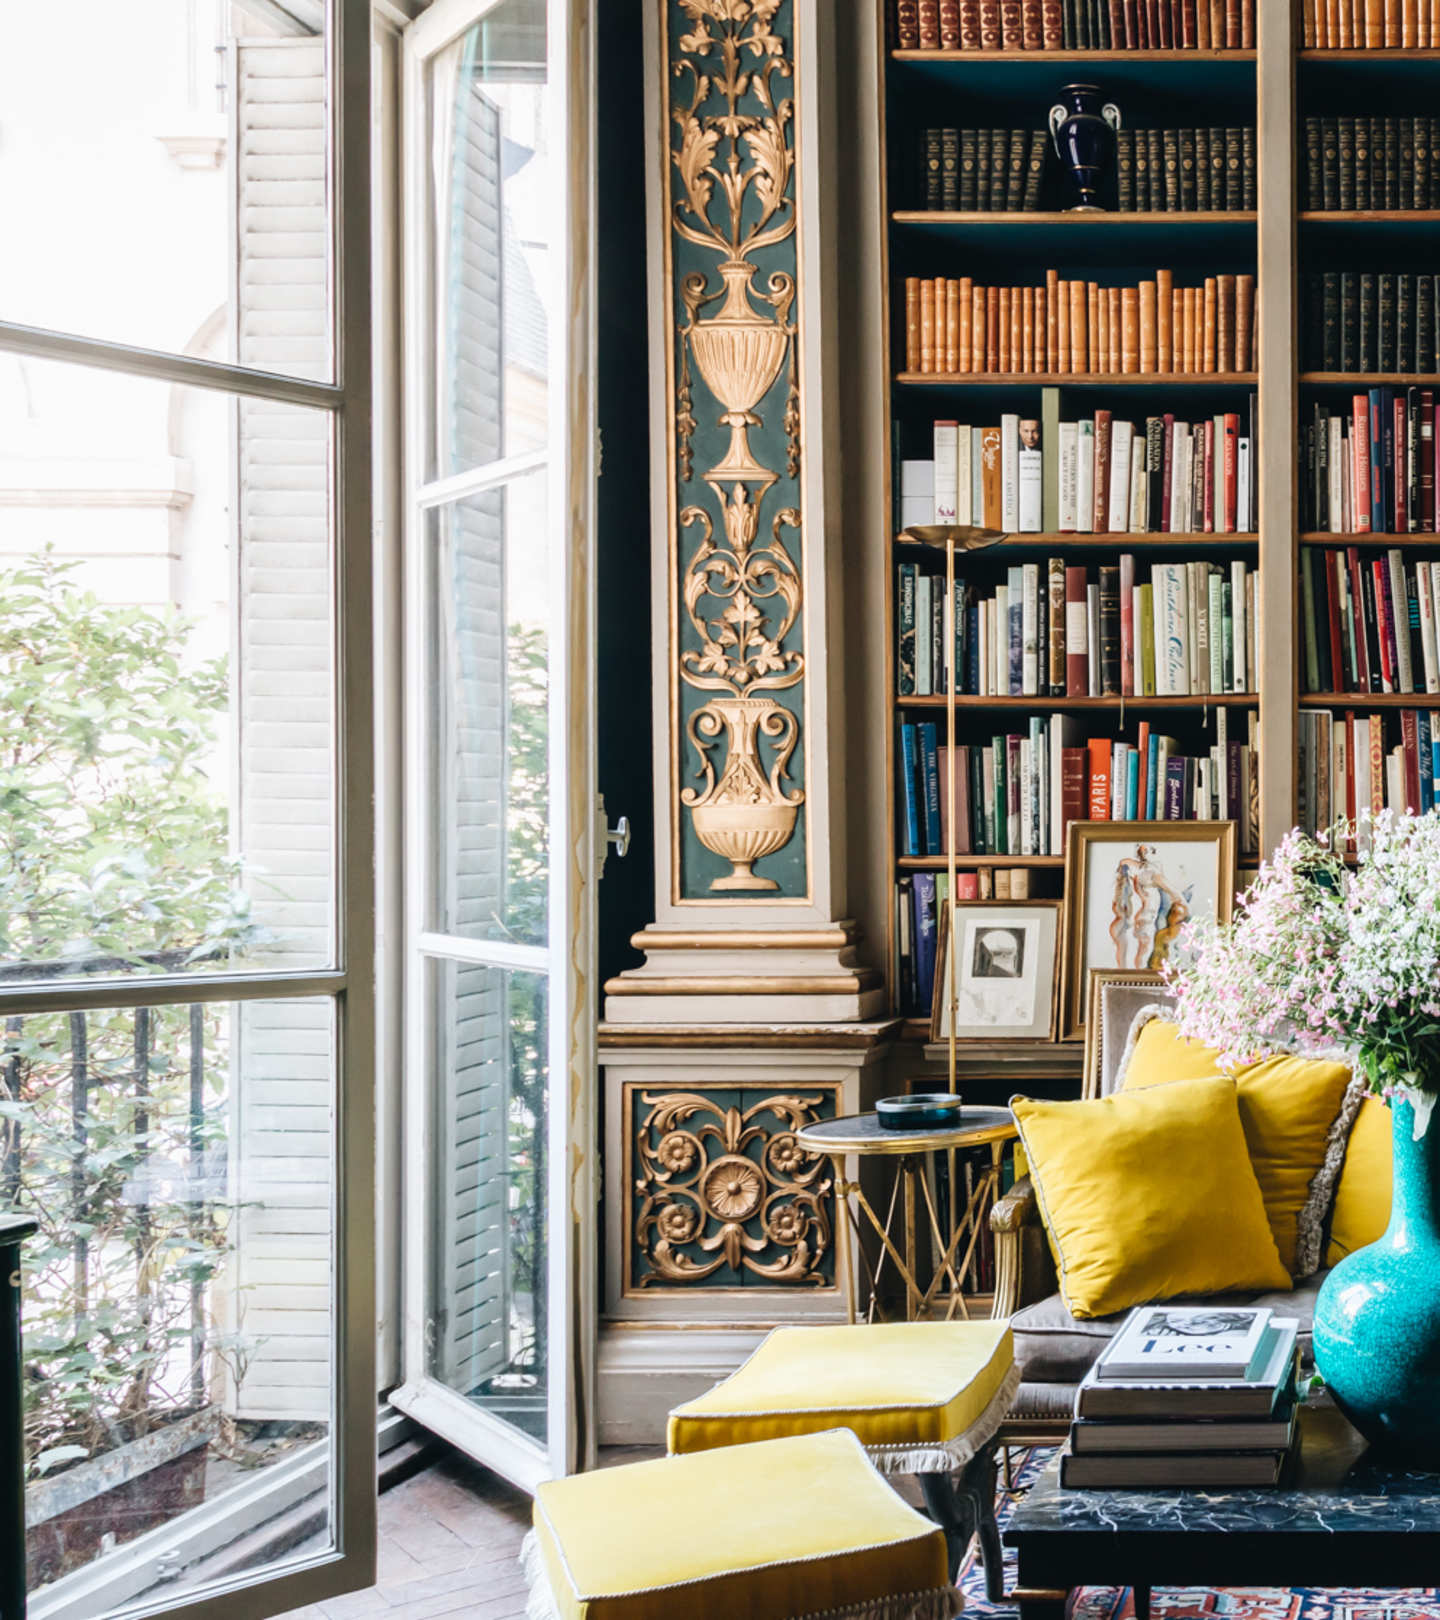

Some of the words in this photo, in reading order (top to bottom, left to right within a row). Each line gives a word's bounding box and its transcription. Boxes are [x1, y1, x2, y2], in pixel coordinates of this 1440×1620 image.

[1357, 415, 1369, 454] Russian
[1358, 455, 1369, 492] Houses
[1165, 567, 1184, 635] Southern
[1198, 608, 1208, 649] LEDOUX
[1168, 636, 1185, 692] Culture
[1404, 717, 1415, 750] JANSEN
[927, 751, 937, 768] THE
[928, 772, 939, 813] VIRGINIA
[1091, 773, 1107, 813] PARIS
[1141, 1339, 1234, 1354] Lee
